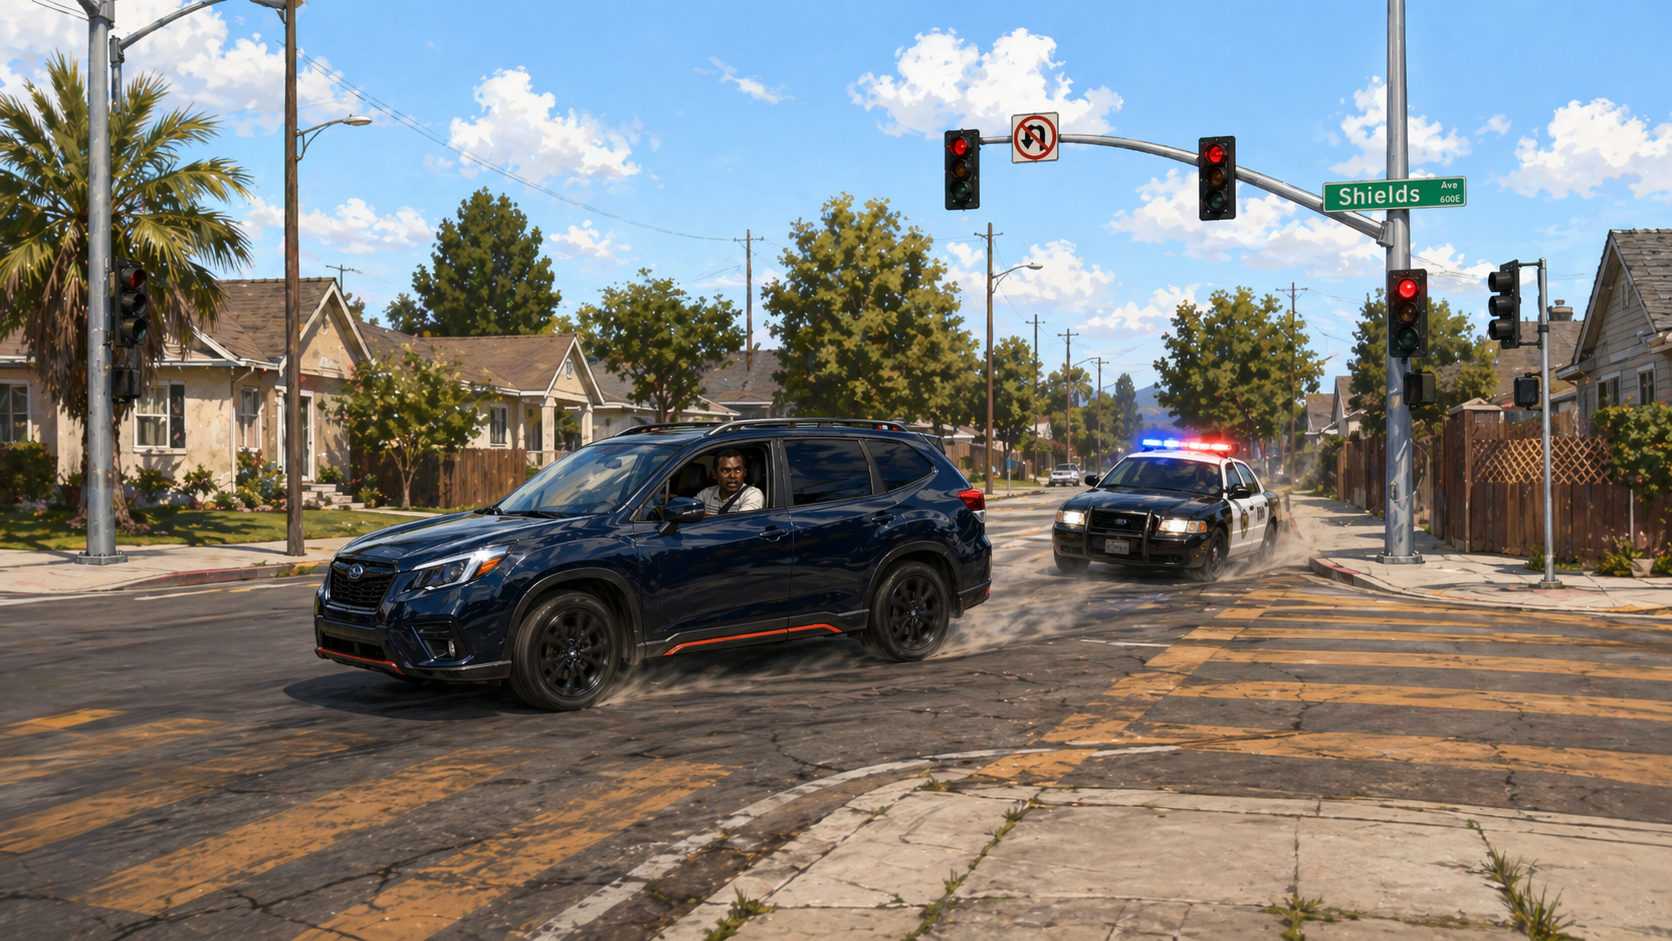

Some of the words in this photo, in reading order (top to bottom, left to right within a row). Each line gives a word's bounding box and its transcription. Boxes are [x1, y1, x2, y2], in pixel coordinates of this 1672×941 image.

[1339, 185, 1420, 205] Shields
[1441, 181, 1458, 189] Ave
[1440, 194, 1461, 203] 600E
